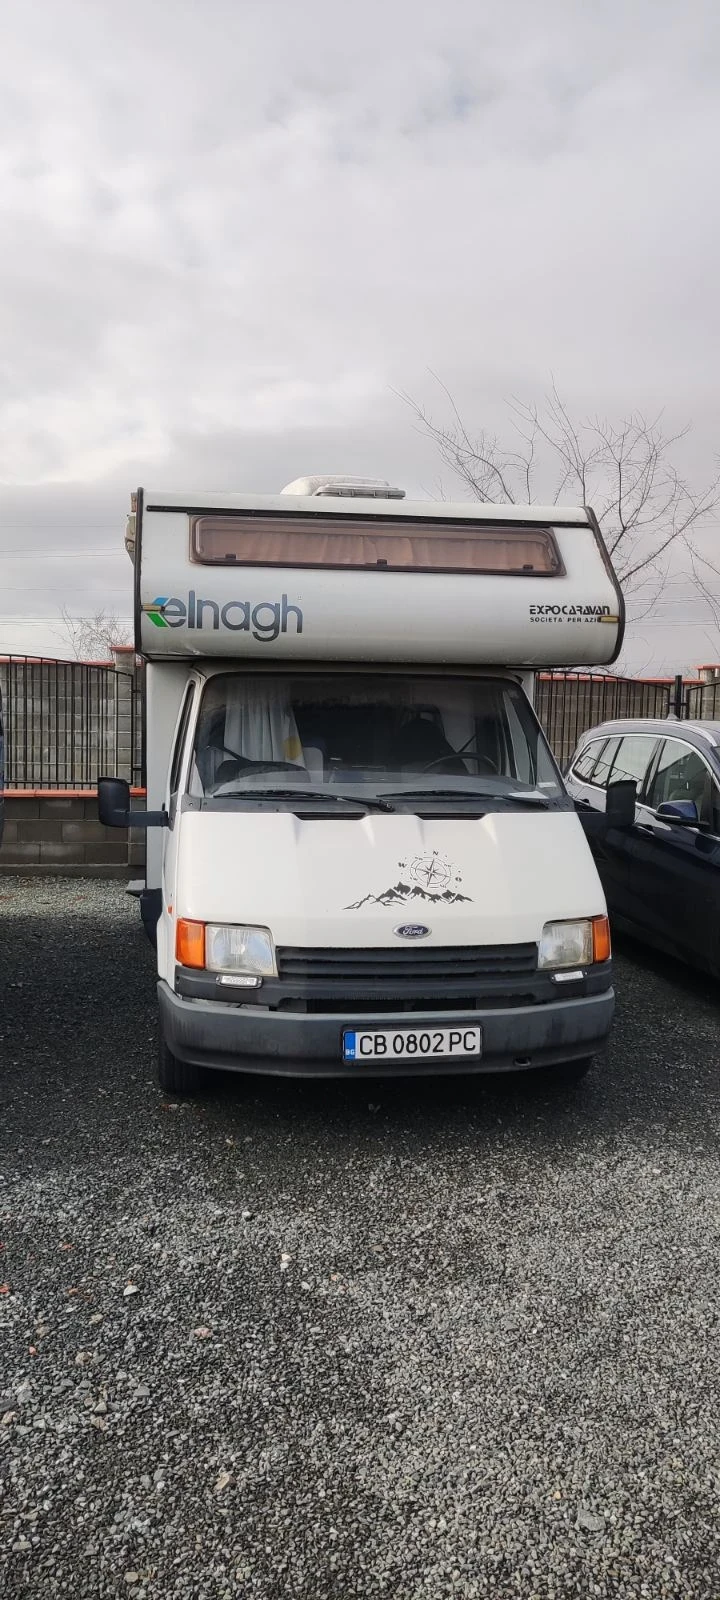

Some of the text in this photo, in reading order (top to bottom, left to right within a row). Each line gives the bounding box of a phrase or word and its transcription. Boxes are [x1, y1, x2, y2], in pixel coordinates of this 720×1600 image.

[162, 590, 303, 642] elnagh
[402, 925, 424, 936] Ford
[359, 1030, 477, 1056] CB 0802 PC
